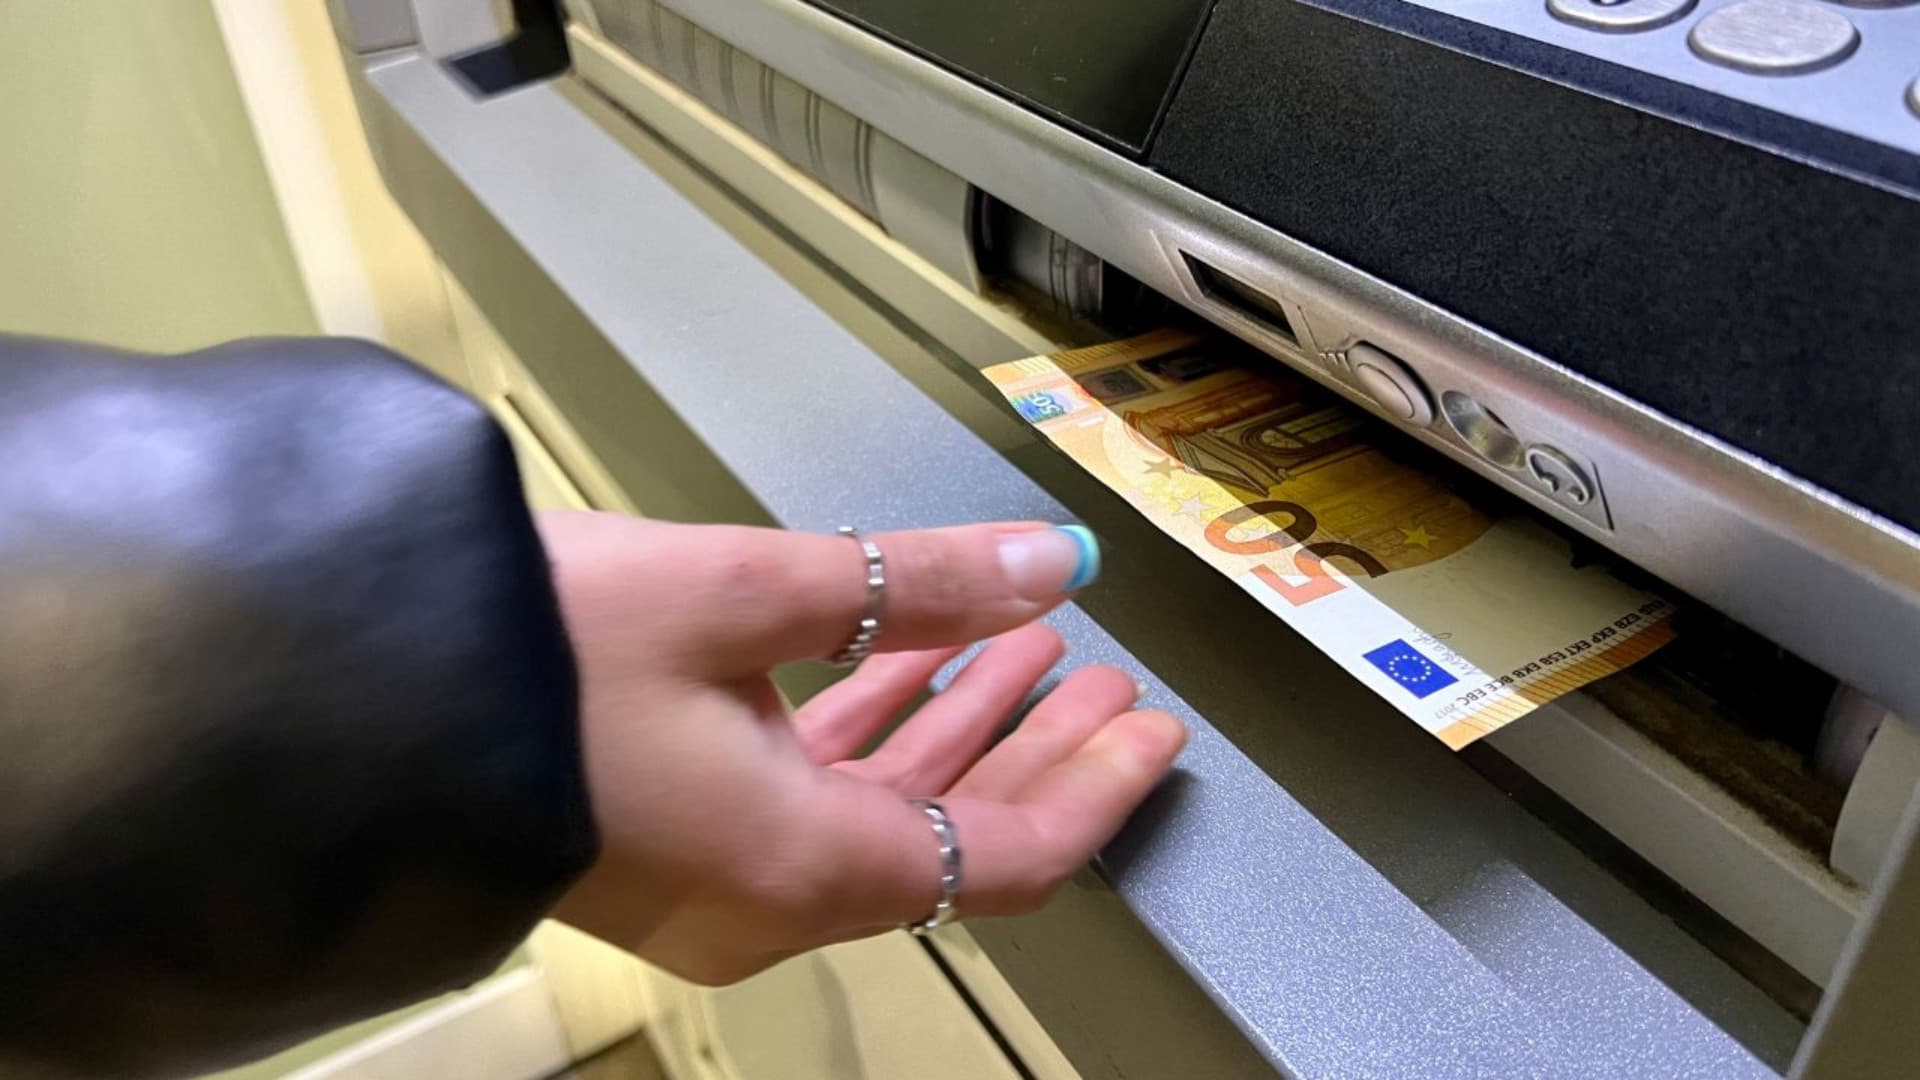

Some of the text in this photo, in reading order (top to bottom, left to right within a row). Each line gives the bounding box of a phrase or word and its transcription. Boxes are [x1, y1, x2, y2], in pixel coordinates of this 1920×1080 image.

[1204, 500, 1389, 607] 50
[1614, 612, 1641, 629] EZB
[1591, 627, 1616, 643] EKP
[1566, 640, 1591, 656] EKT
[1540, 651, 1566, 666] ESB
[1513, 662, 1540, 678] EKB
[1456, 688, 1487, 705] EBC
